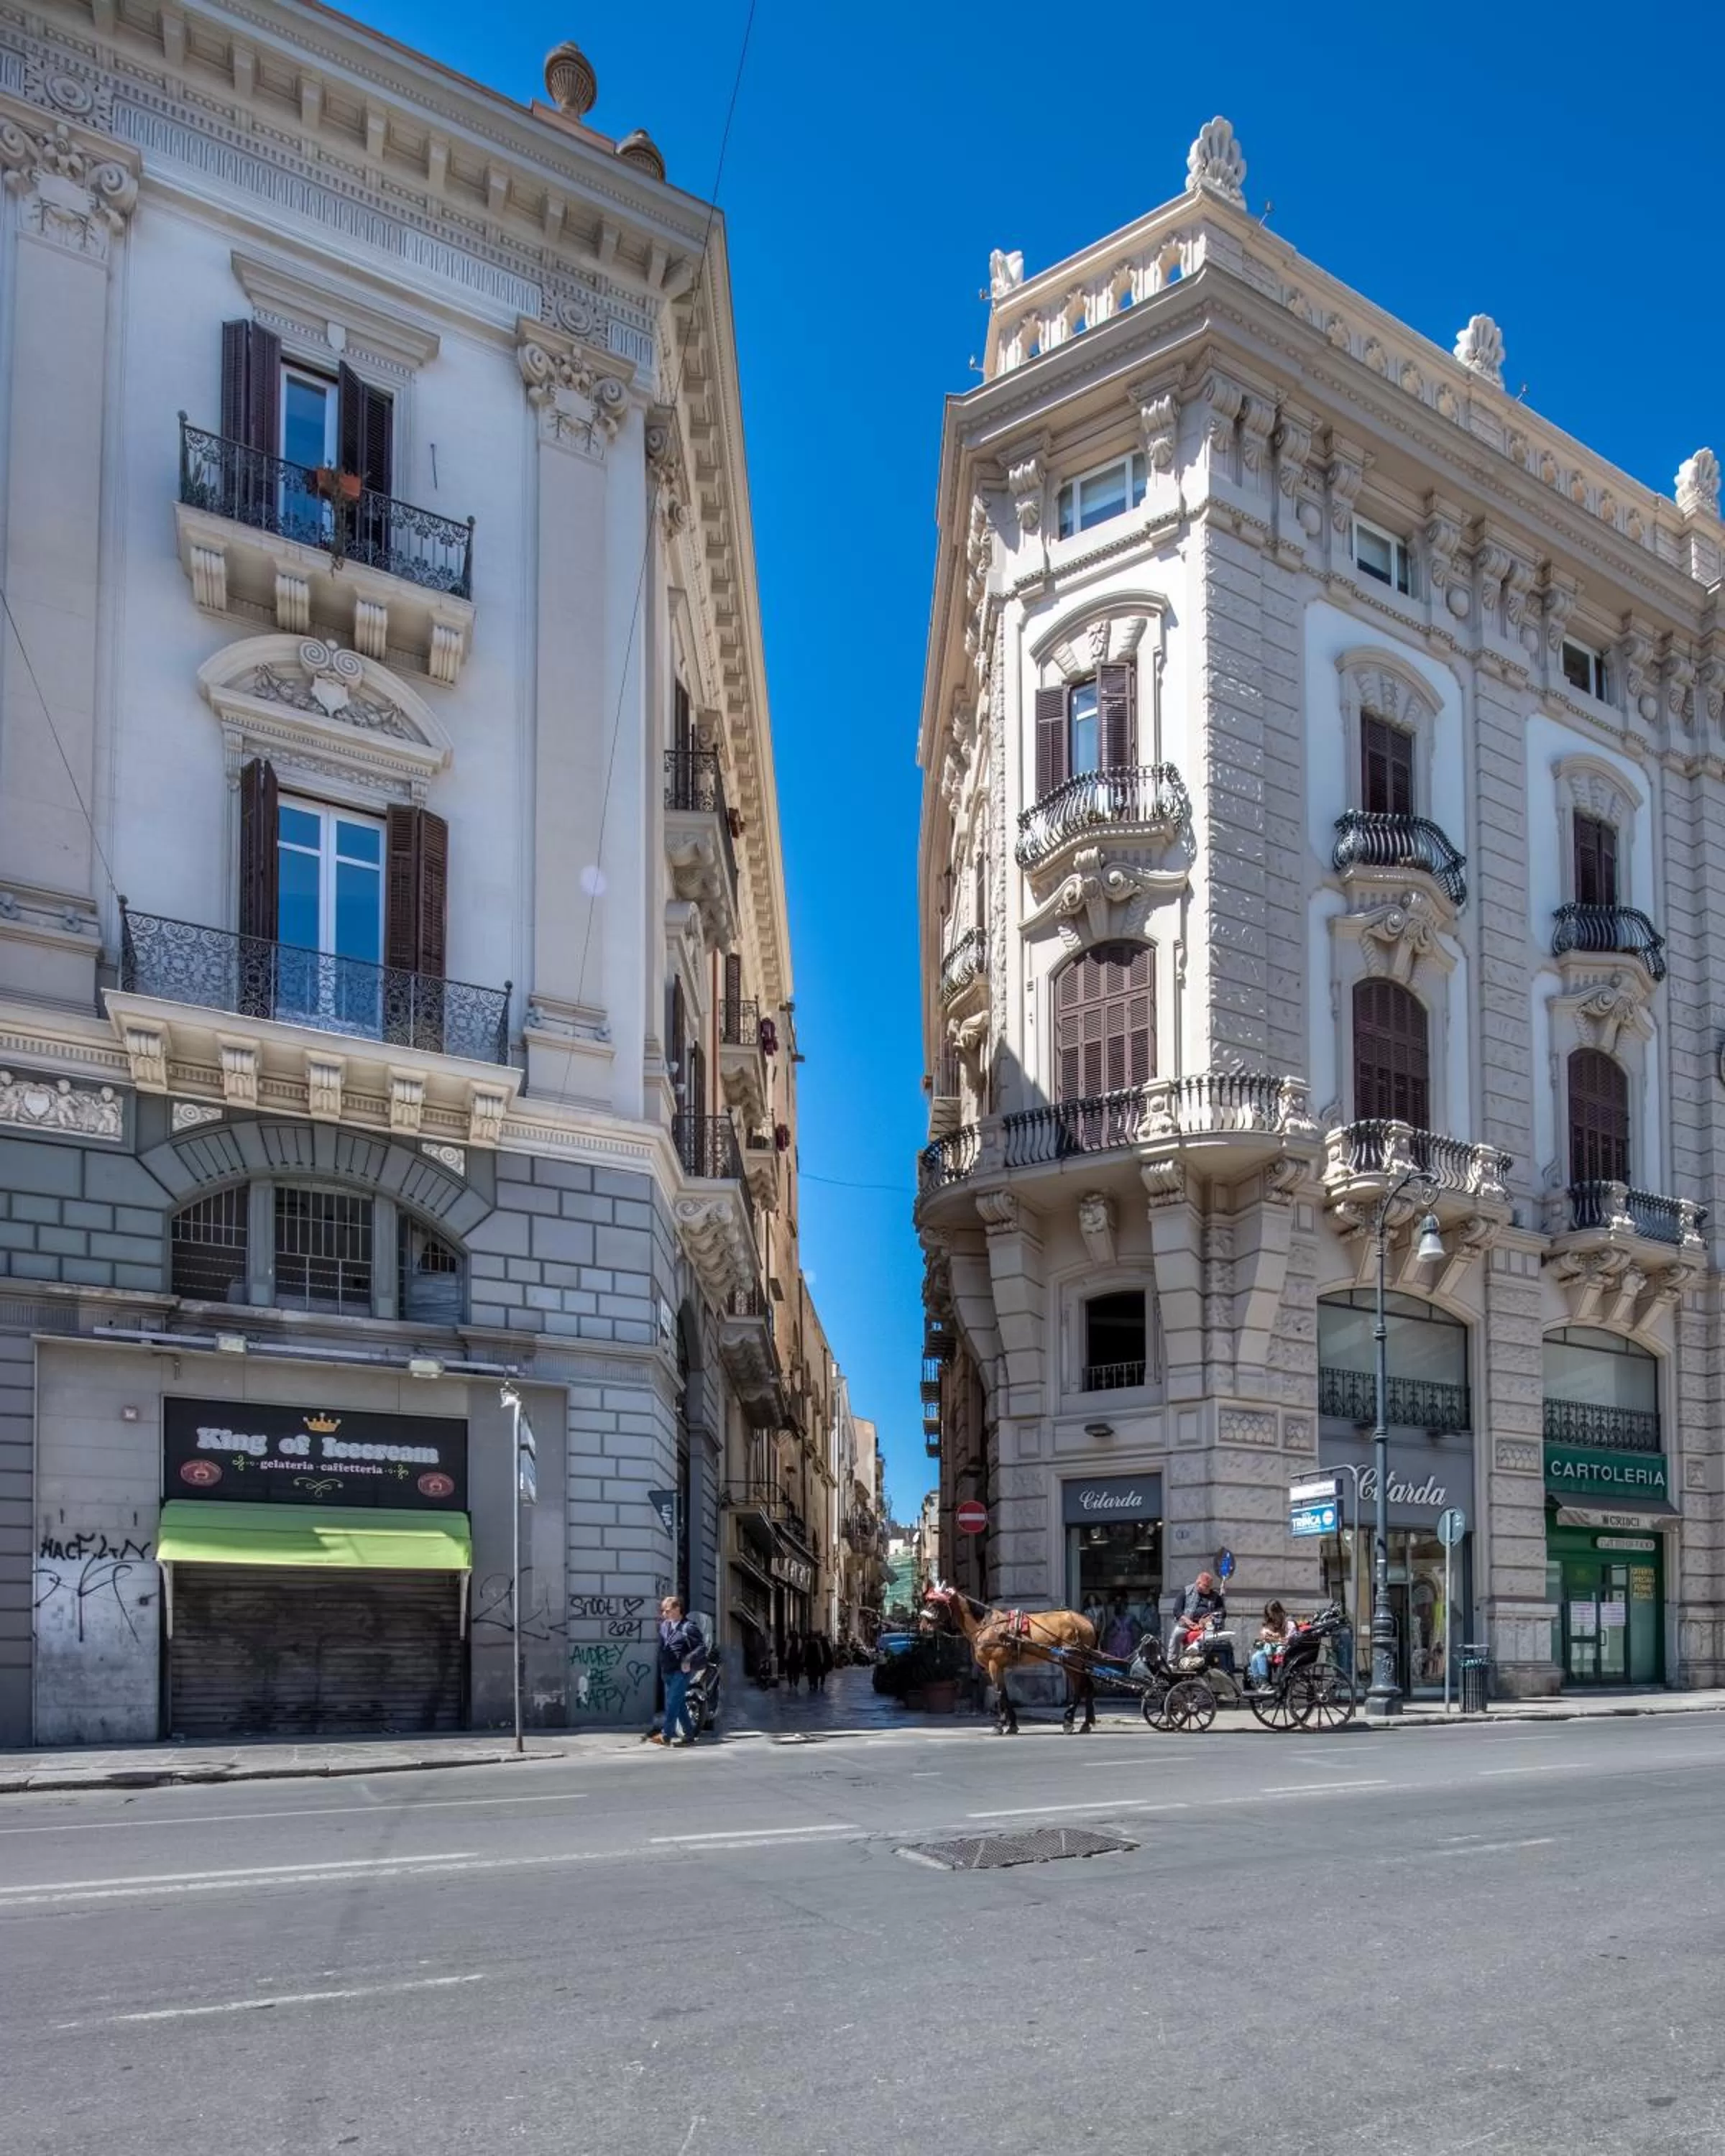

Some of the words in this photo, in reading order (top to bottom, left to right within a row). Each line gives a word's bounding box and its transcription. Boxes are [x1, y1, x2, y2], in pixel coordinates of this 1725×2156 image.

[196, 1427, 268, 1456] King
[278, 1434, 311, 1455] of
[321, 1437, 440, 1464] Icecream
[259, 1460, 314, 1470] gelateria
[320, 1462, 383, 1474] caffetteria
[1550, 1460, 1665, 1486] CARTOLERIA
[1080, 1490, 1143, 1510] Citarda
[569, 1643, 629, 1665] AUDREY
[589, 1667, 615, 1685] BE
